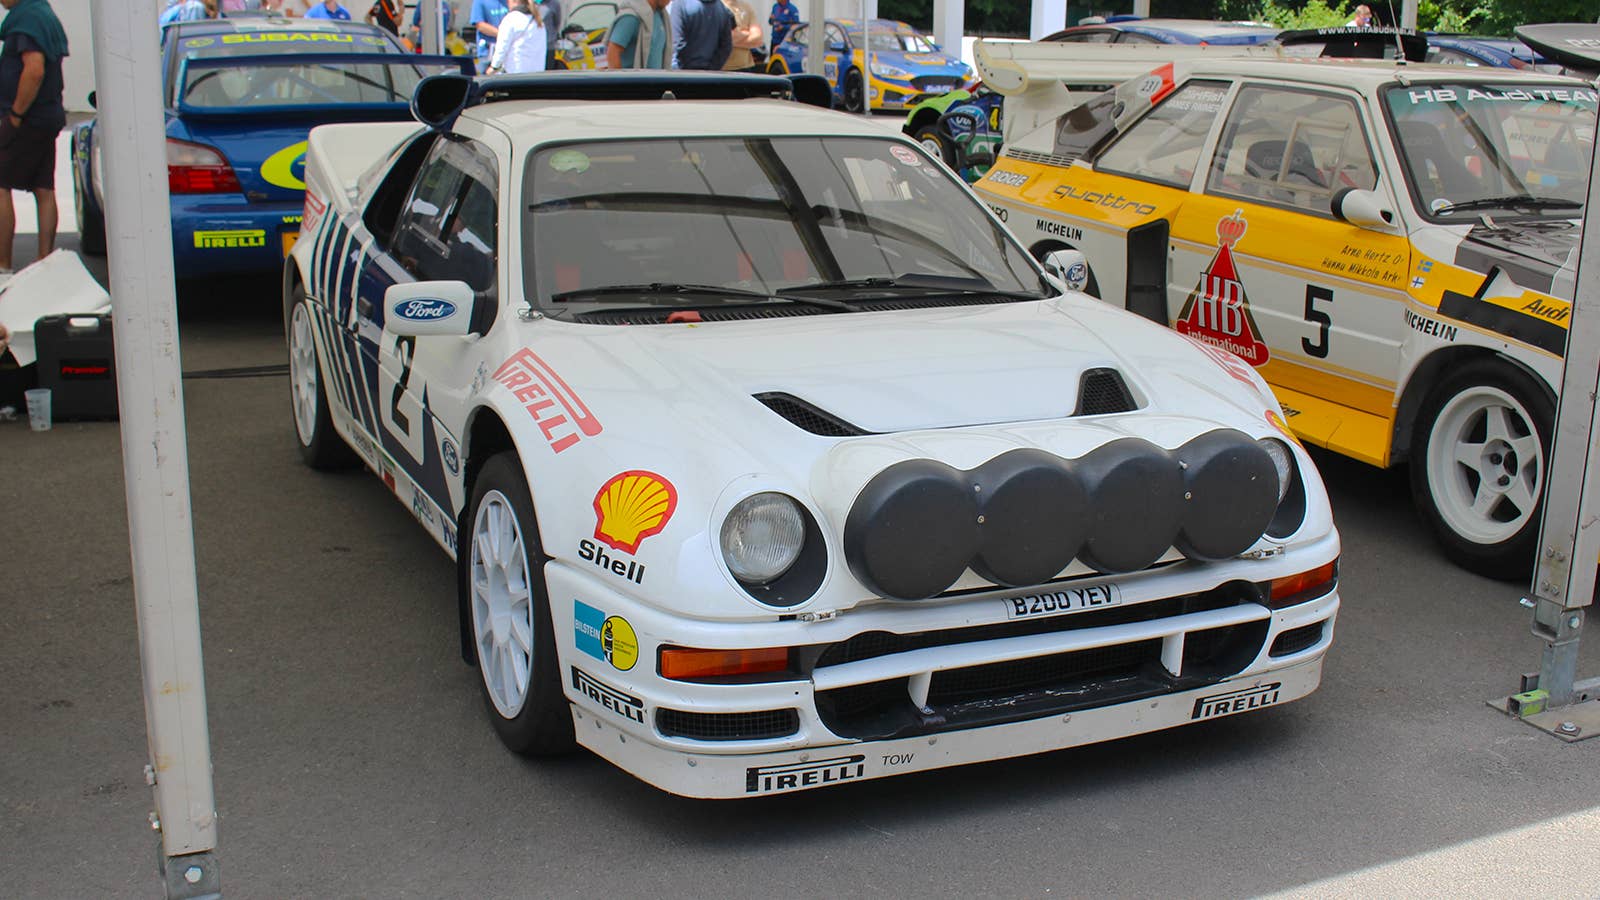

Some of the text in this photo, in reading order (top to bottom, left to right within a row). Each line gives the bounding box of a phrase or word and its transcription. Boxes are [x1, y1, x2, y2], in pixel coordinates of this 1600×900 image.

[222, 33, 353, 44] SUBARU
[1409, 89, 1457, 104] HB
[1054, 184, 1157, 215] quattro
[193, 229, 266, 248] PIRELLI
[1036, 219, 1083, 241] MICHELIN
[1340, 245, 1362, 258] Arne
[1364, 249, 1391, 264] Hertz
[1349, 262, 1380, 279] Mikkola
[404, 300, 444, 317] Ford
[1197, 272, 1244, 337] HB
[1521, 298, 1569, 321] Audi
[1301, 284, 1334, 359] 5
[1404, 308, 1457, 342] MICHELIN
[1187, 327, 1257, 360] international
[391, 335, 416, 438] 2
[491, 347, 604, 454] PIRELLI
[578, 538, 646, 584] Shell
[1015, 583, 1113, 616] B200 YEV
[575, 619, 601, 641] BILSTEIN
[571, 665, 644, 724] PIRELLI
[1191, 681, 1282, 721] PIRELLI
[746, 754, 866, 793] PIRELLI
[882, 753, 915, 766] TOW
